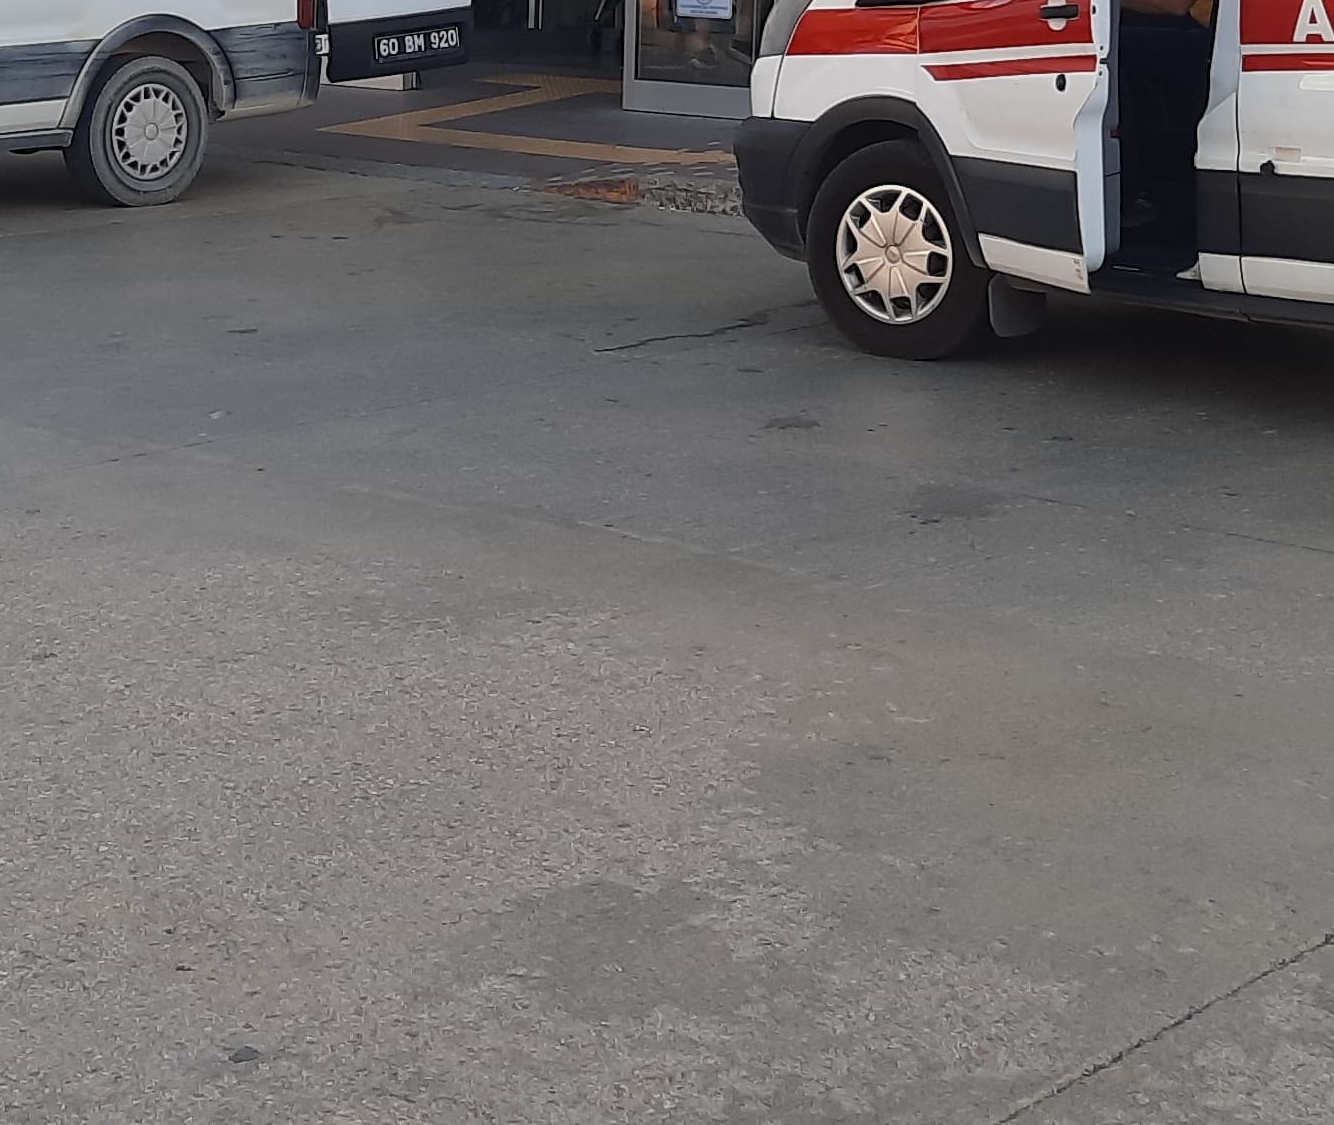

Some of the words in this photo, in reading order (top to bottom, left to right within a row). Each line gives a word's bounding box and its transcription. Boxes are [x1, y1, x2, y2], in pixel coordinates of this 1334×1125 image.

[379, 38, 399, 57] 60
[405, 34, 425, 53] BM
[430, 29, 457, 48] 920
